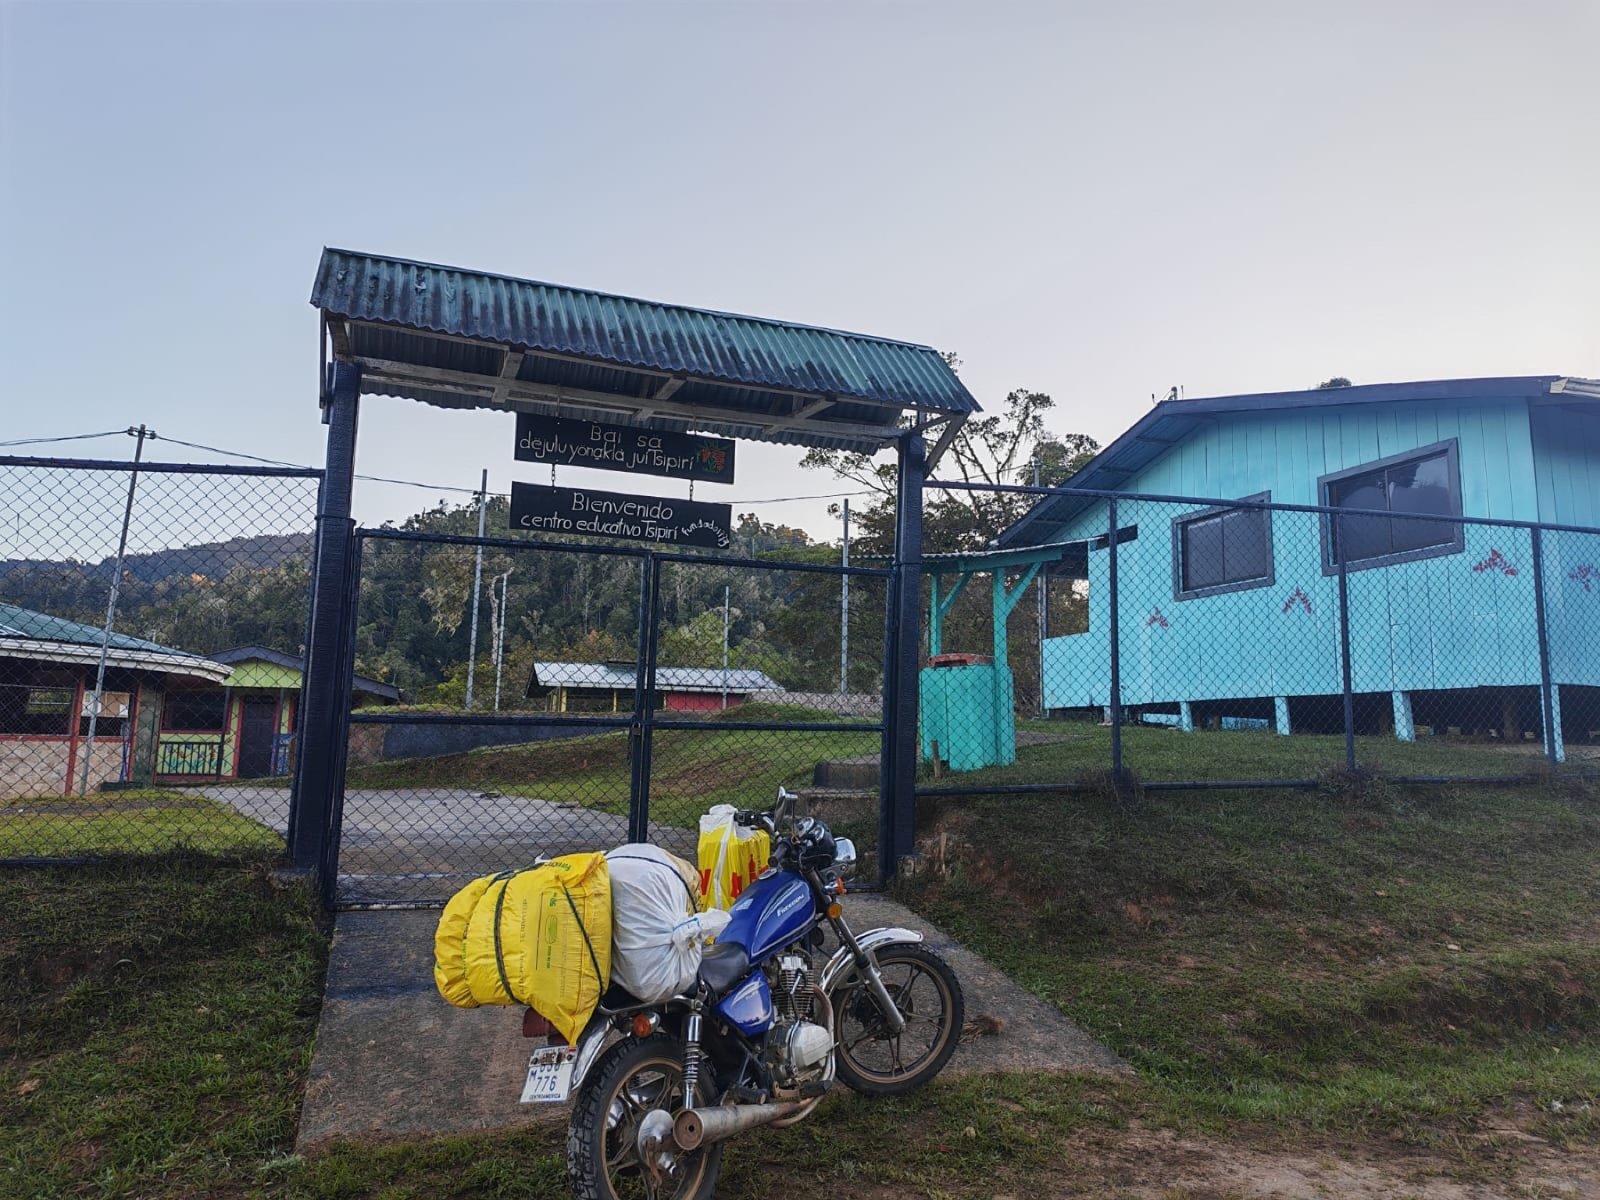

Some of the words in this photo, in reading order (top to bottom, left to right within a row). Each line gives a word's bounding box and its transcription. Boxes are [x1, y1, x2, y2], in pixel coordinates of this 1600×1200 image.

[590, 424, 622, 444] Bai
[572, 491, 674, 521] Bienvenido
[520, 511, 573, 531] centro
[576, 514, 642, 537] educativo
[529, 1069, 538, 1081] M
[534, 1075, 558, 1092] 776
